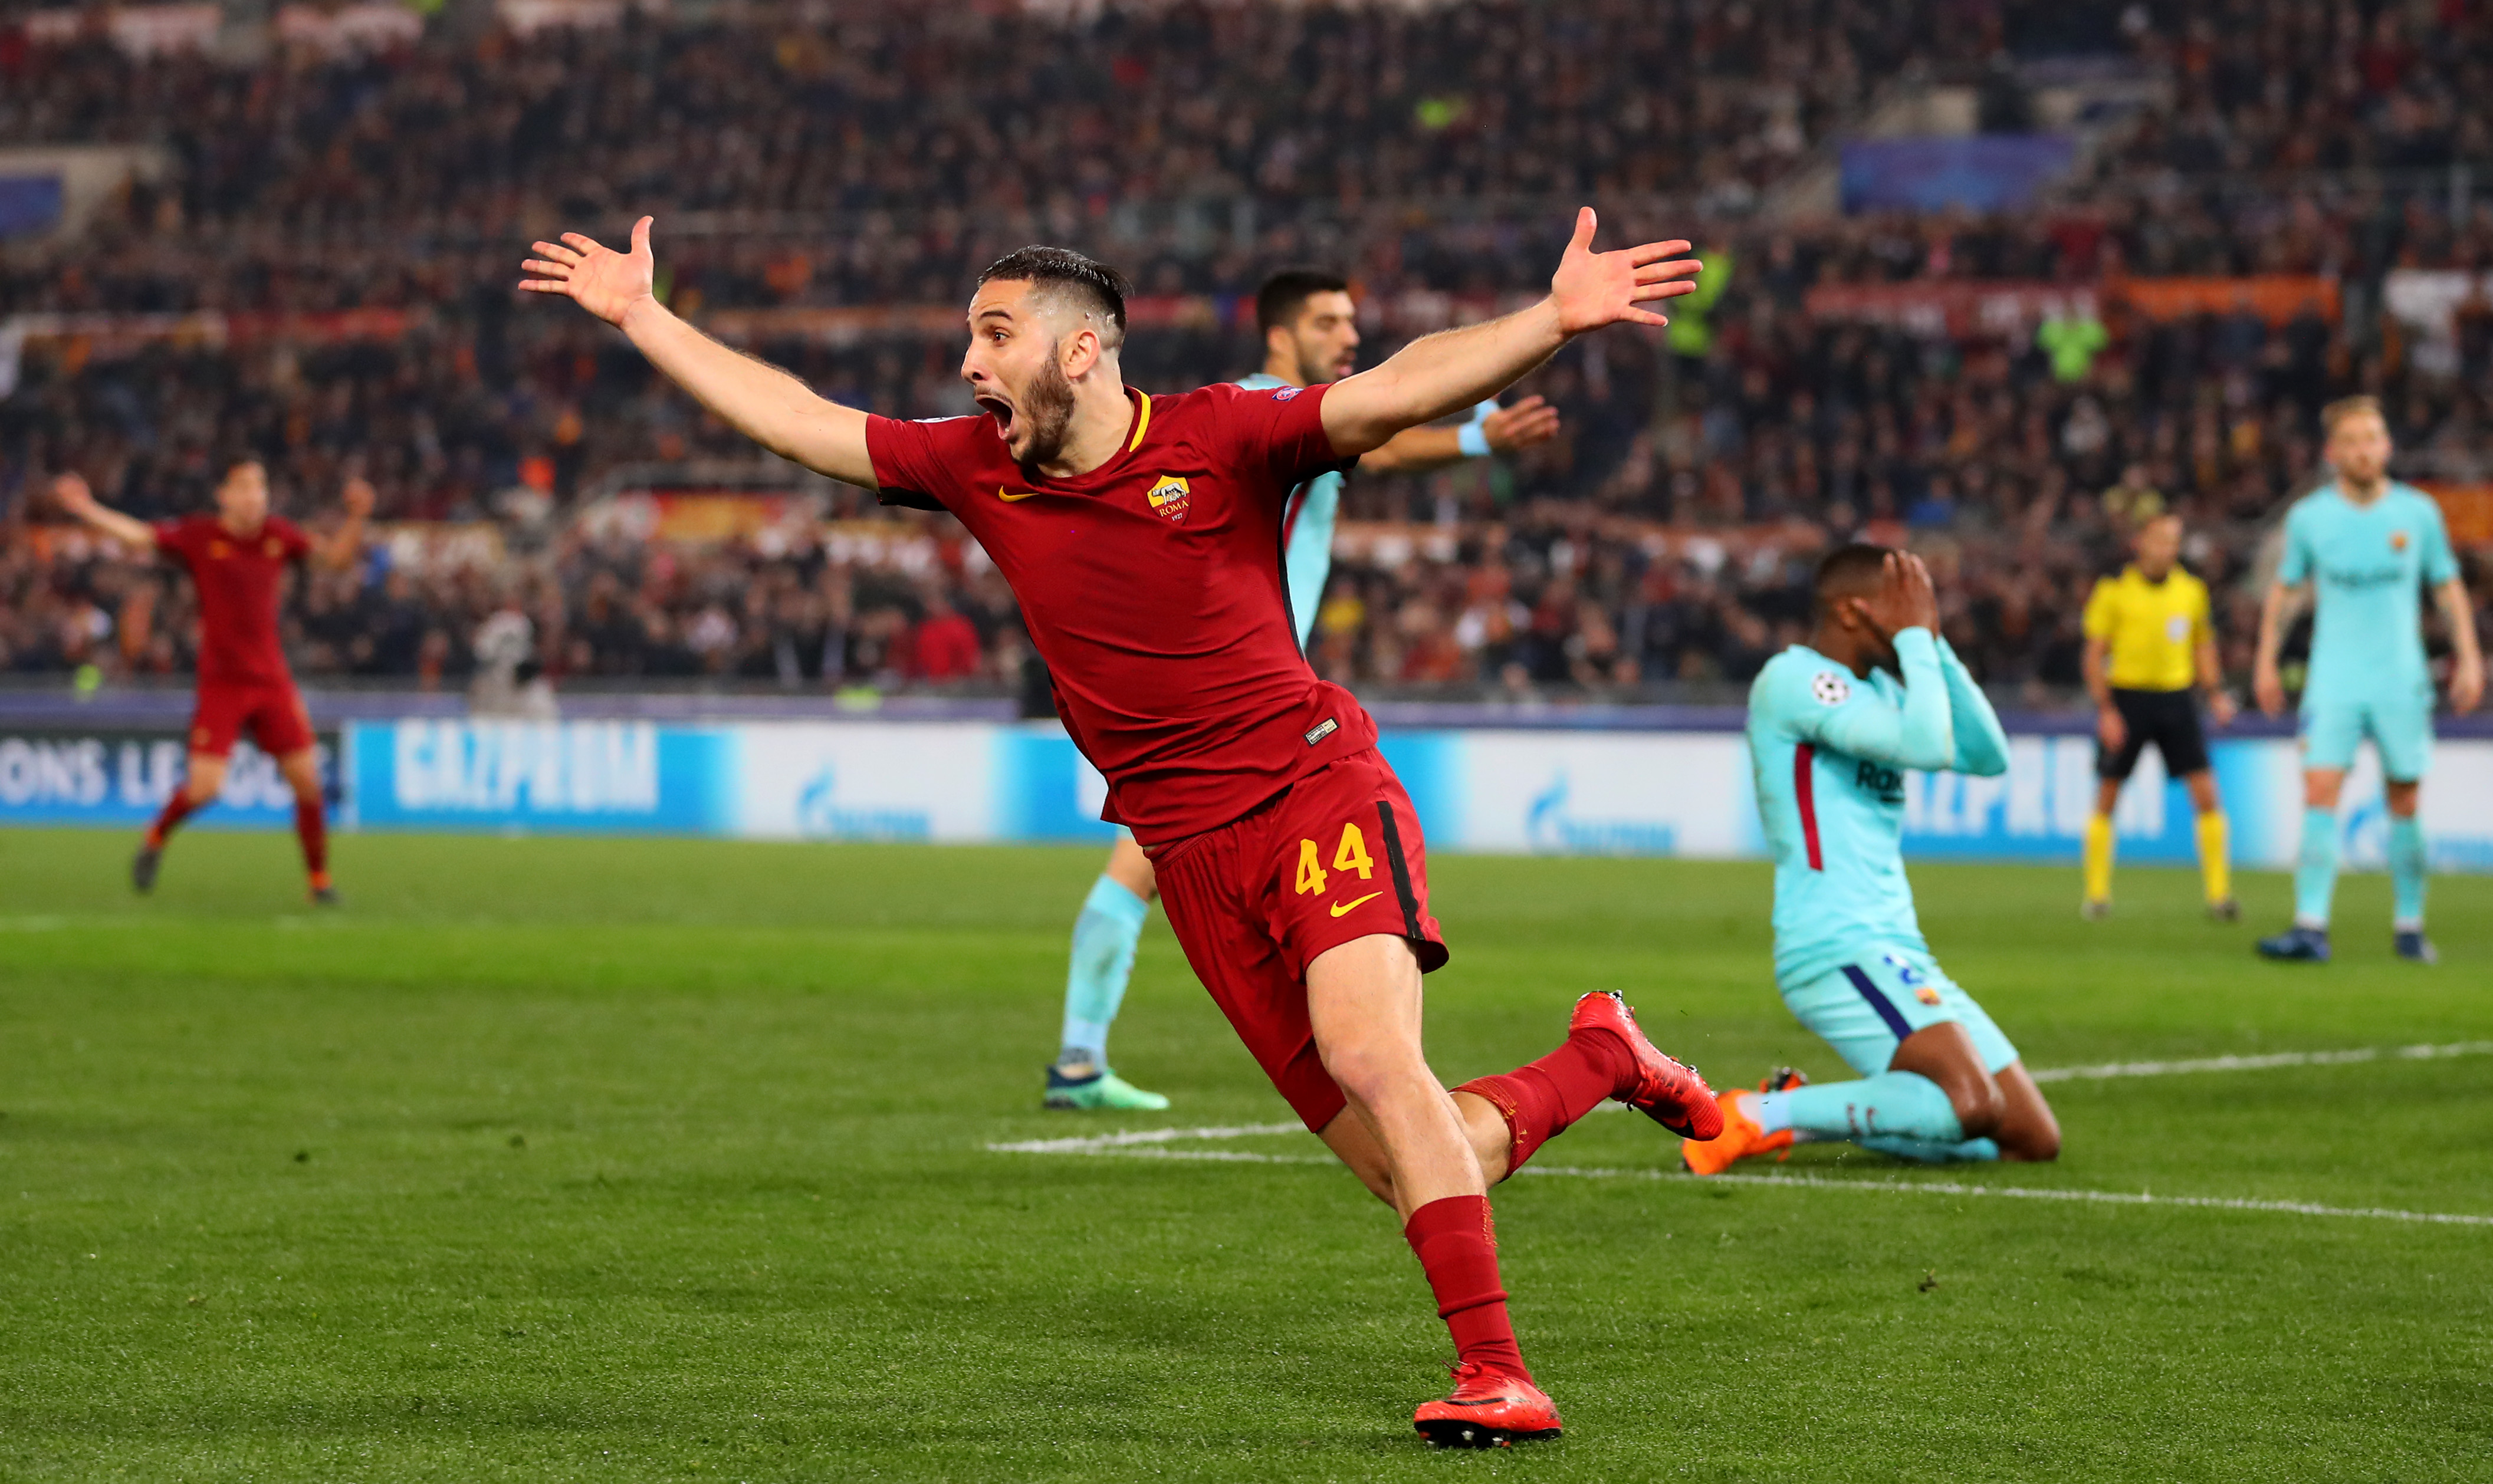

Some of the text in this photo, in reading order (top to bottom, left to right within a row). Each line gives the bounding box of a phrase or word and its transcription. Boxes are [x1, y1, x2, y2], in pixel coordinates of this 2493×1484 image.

[1159, 499, 1188, 516] ROMA
[1171, 512, 1183, 521] 1927
[1295, 822, 1374, 896] 44
